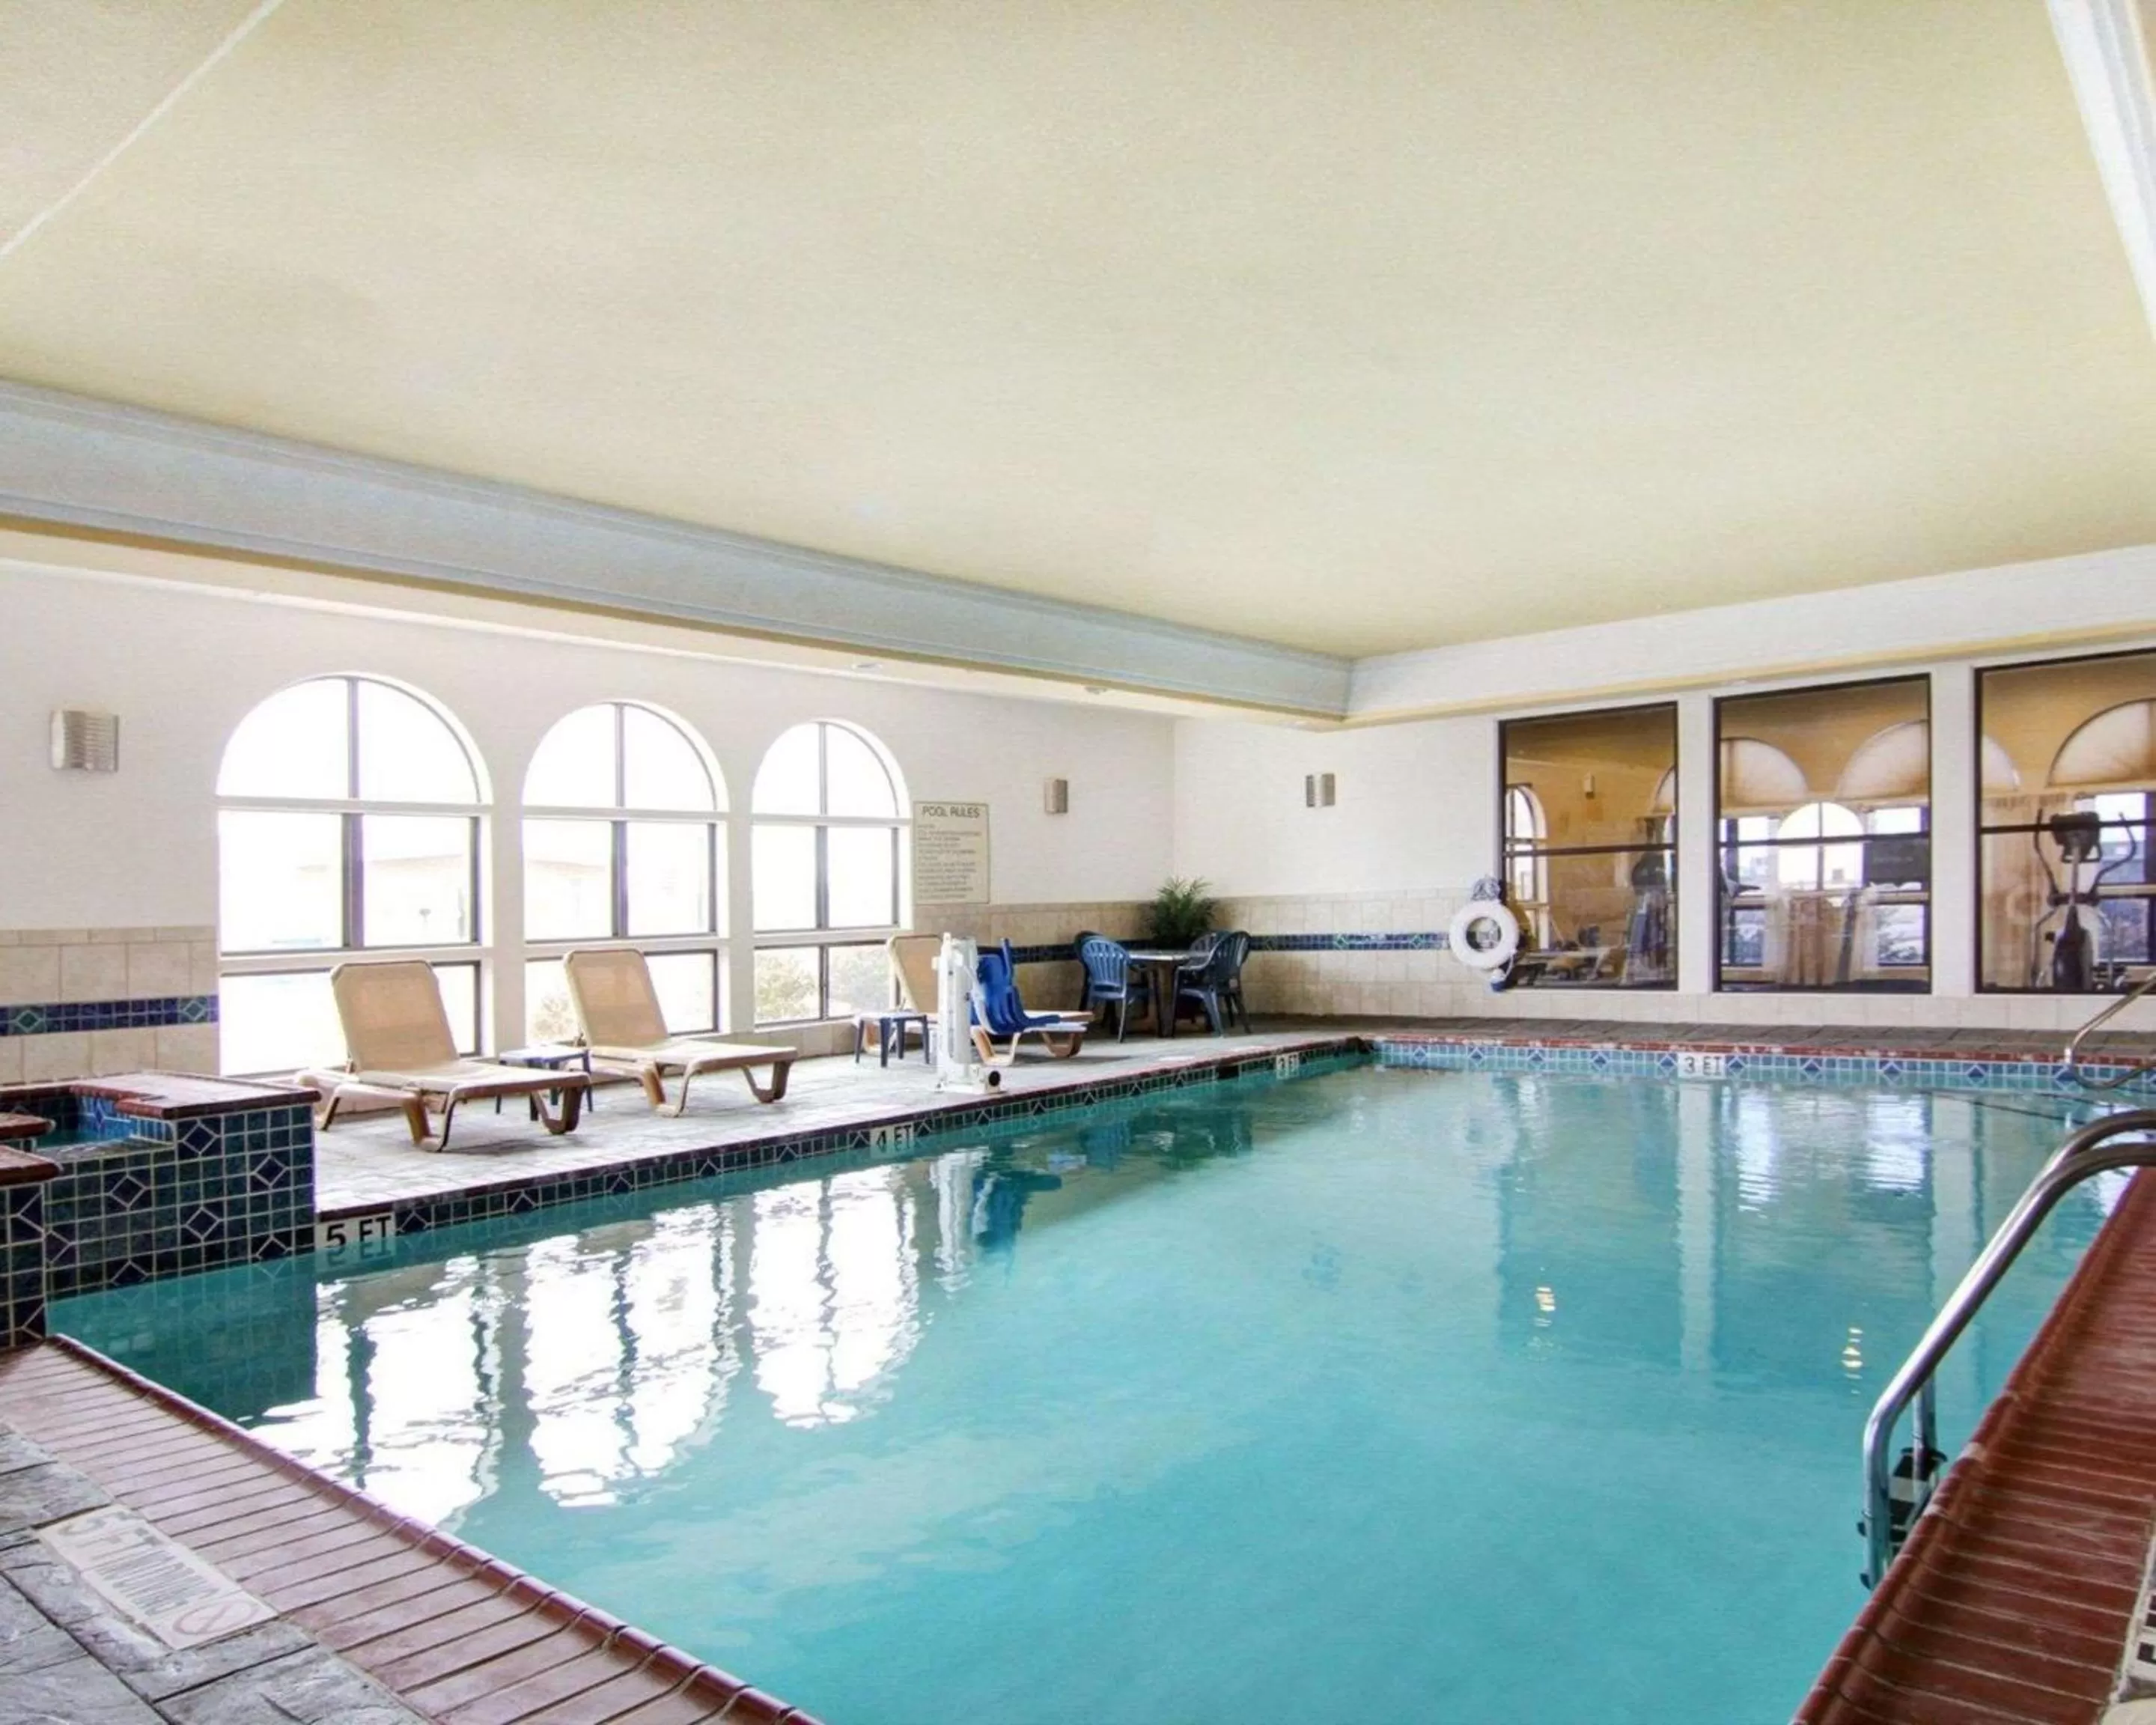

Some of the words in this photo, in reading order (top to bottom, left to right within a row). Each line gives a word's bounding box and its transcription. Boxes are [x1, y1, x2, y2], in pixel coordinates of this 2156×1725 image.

[922, 806, 948, 818] POOL
[950, 806, 980, 818] RULES
[326, 1223, 347, 1248] 5
[360, 1216, 391, 1242] FT
